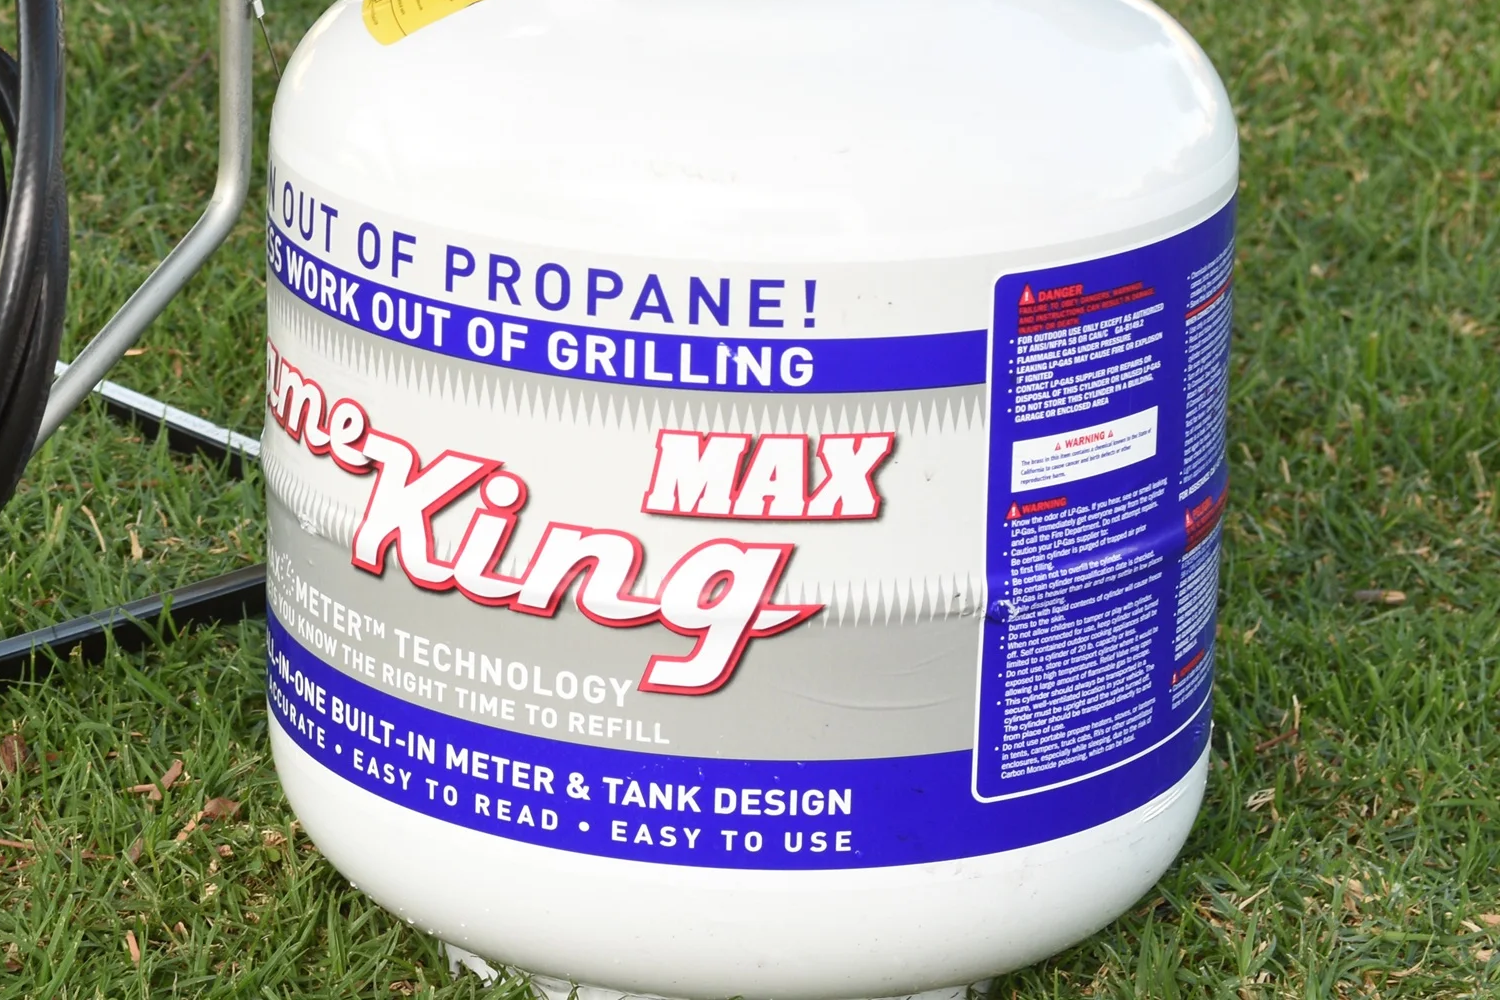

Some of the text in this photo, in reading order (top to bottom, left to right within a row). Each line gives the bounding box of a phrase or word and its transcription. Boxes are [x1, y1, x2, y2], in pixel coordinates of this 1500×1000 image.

[283, 181, 338, 254] OUT
[357, 221, 417, 279] OF
[445, 244, 817, 329] PROPANE!
[1038, 284, 1082, 301] DANGER
[286, 245, 360, 322] WORK
[372, 291, 452, 348] OUT
[467, 319, 529, 362] OF
[547, 330, 815, 388] GRILLING
[1017, 335, 1032, 344] FOR
[1033, 329, 1066, 342] OUTDOOR
[1068, 326, 1081, 336] USE
[1082, 322, 1099, 333] ONLY
[1100, 316, 1122, 329] EXCEPT
[1123, 313, 1131, 322] AS
[1016, 332, 1162, 374] LEAKING LP-GAS MAY CAUSE FIRE OR EXPLOSION
[1017, 345, 1027, 354] BY
[1029, 338, 1067, 352] ANSI/NFPA
[1077, 334, 1087, 343] OR
[1017, 333, 1131, 364] FLAMMABLE GAS UNDER PRESSURE
[1015, 354, 1151, 393] CONTACT LP-GAS SUPPLIER FOR REPAIRS OR
[1016, 371, 1053, 383] IF IGNITED
[1015, 391, 1050, 403] DISPOSAL
[1051, 388, 1061, 397] OF
[1063, 385, 1078, 394] THIS
[1079, 377, 1109, 391] CYLINDER
[1110, 374, 1119, 383] OR
[1015, 404, 1026, 413] DO
[1027, 401, 1042, 410] NOT
[1043, 397, 1066, 408] STORE
[1067, 393, 1082, 403] THIS
[1083, 385, 1114, 399] CYLINDER
[1014, 397, 1108, 422] GARAGE OR ENCLOSED AREA
[1065, 431, 1104, 448] WARNING
[642, 429, 896, 520] MAX
[1011, 519, 1030, 527] Know
[1043, 513, 1058, 521] odor
[1059, 509, 1067, 518] of
[1022, 497, 1065, 513] WARNING
[1010, 546, 1037, 556] Caution
[1011, 537, 1024, 547] and
[1025, 535, 1037, 544] call
[1039, 533, 1050, 541] the
[1051, 530, 1063, 539] Fire
[351, 429, 825, 696] King
[1010, 568, 1018, 576] to
[1012, 577, 1022, 586] Be
[1023, 573, 1047, 583] certain
[1047, 570, 1059, 578] not
[279, 591, 295, 627] YOU
[298, 614, 337, 658] KNOW
[342, 644, 375, 678] THE
[383, 661, 447, 703] RIGHT
[455, 687, 515, 722] TIME
[525, 703, 558, 729] TO
[569, 711, 670, 745] REFILL
[394, 628, 633, 708] TECHNOLOGY
[1042, 725, 1050, 733] of
[269, 674, 853, 853] ACCURATE EASY TO READ EASY TO USE
[331, 702, 436, 766] BUILT-IN
[445, 744, 555, 795] METER
[566, 771, 591, 801] &
[602, 775, 701, 813] TANK
[714, 788, 852, 817] DESIGN
[1000, 769, 1025, 779] Carbon
